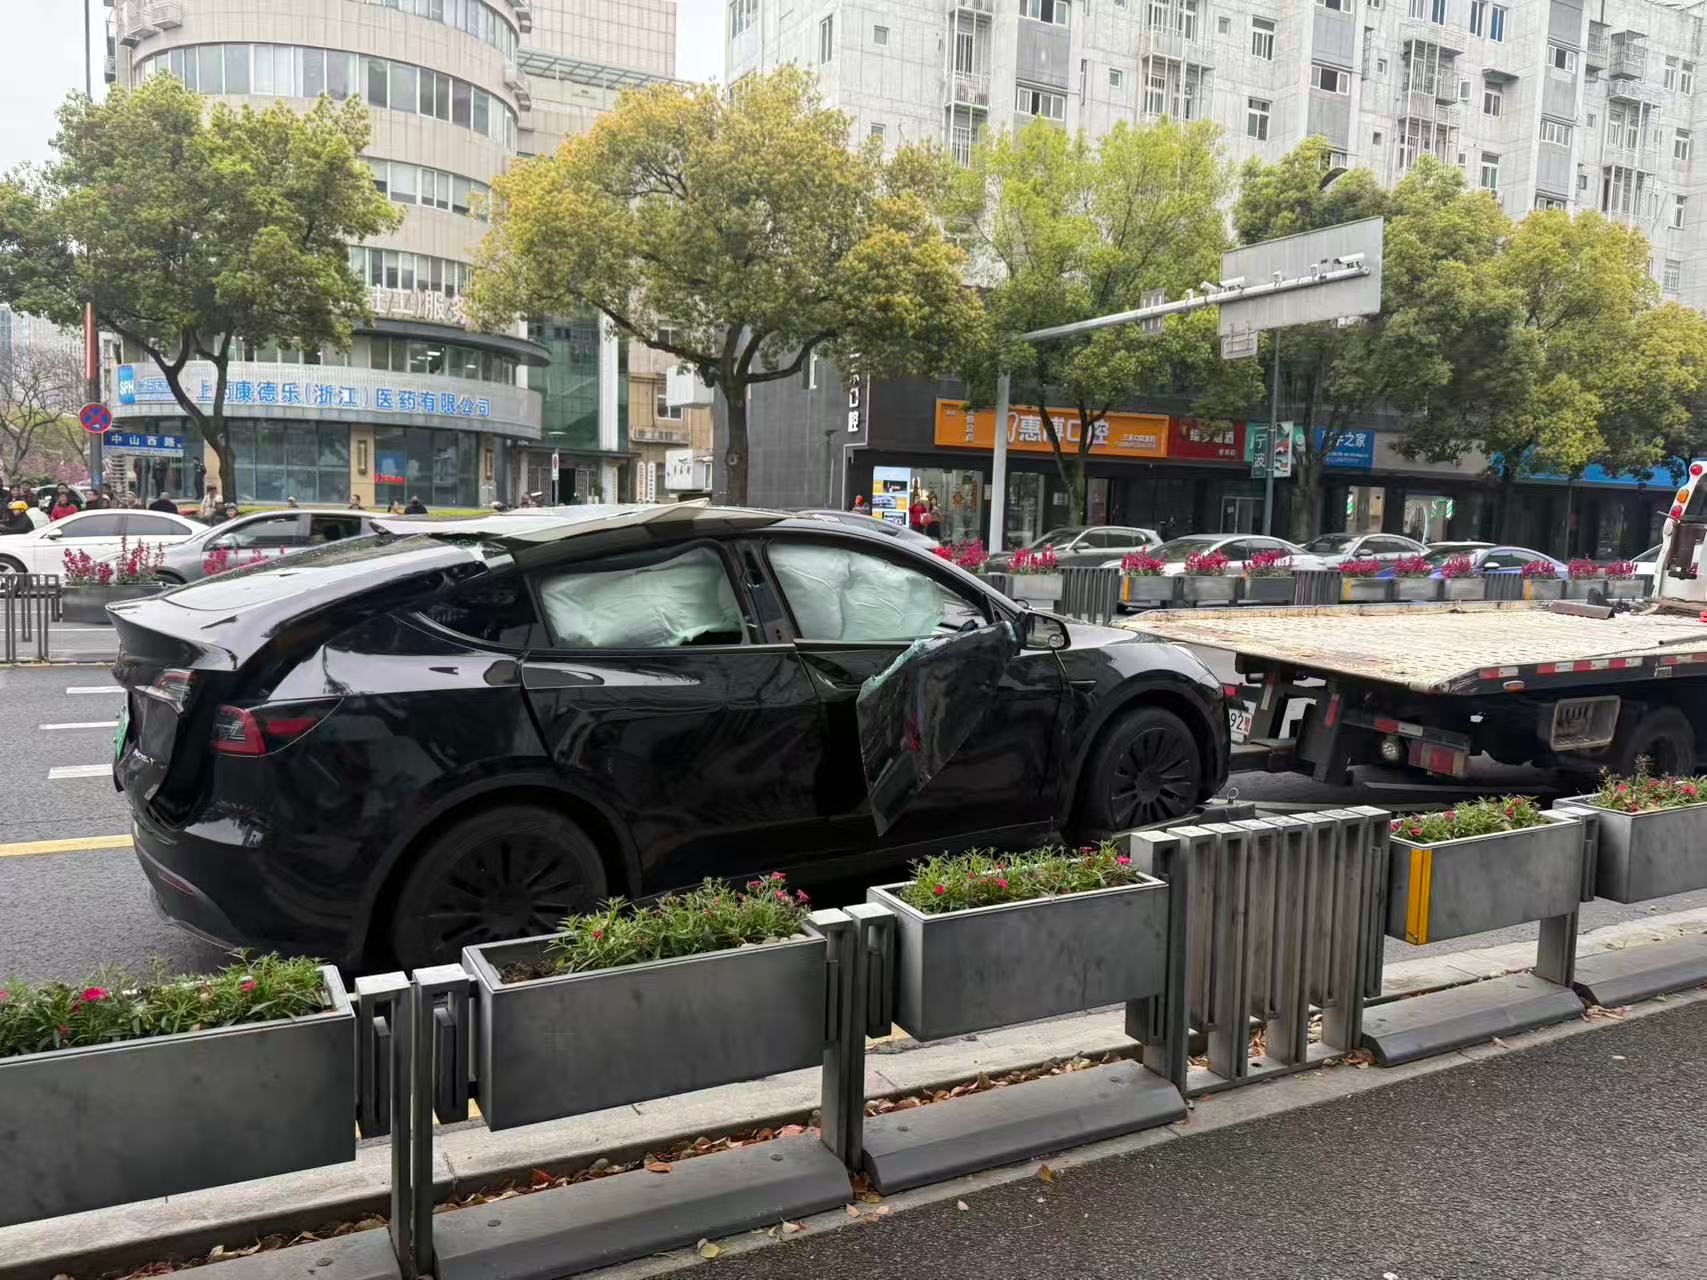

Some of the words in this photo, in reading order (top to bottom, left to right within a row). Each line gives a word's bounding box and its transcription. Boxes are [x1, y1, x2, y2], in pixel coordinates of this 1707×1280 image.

[120, 379, 134, 394] SPH
[111, 434, 175, 448] 中山西路
[1253, 433, 1267, 468] 宁波
